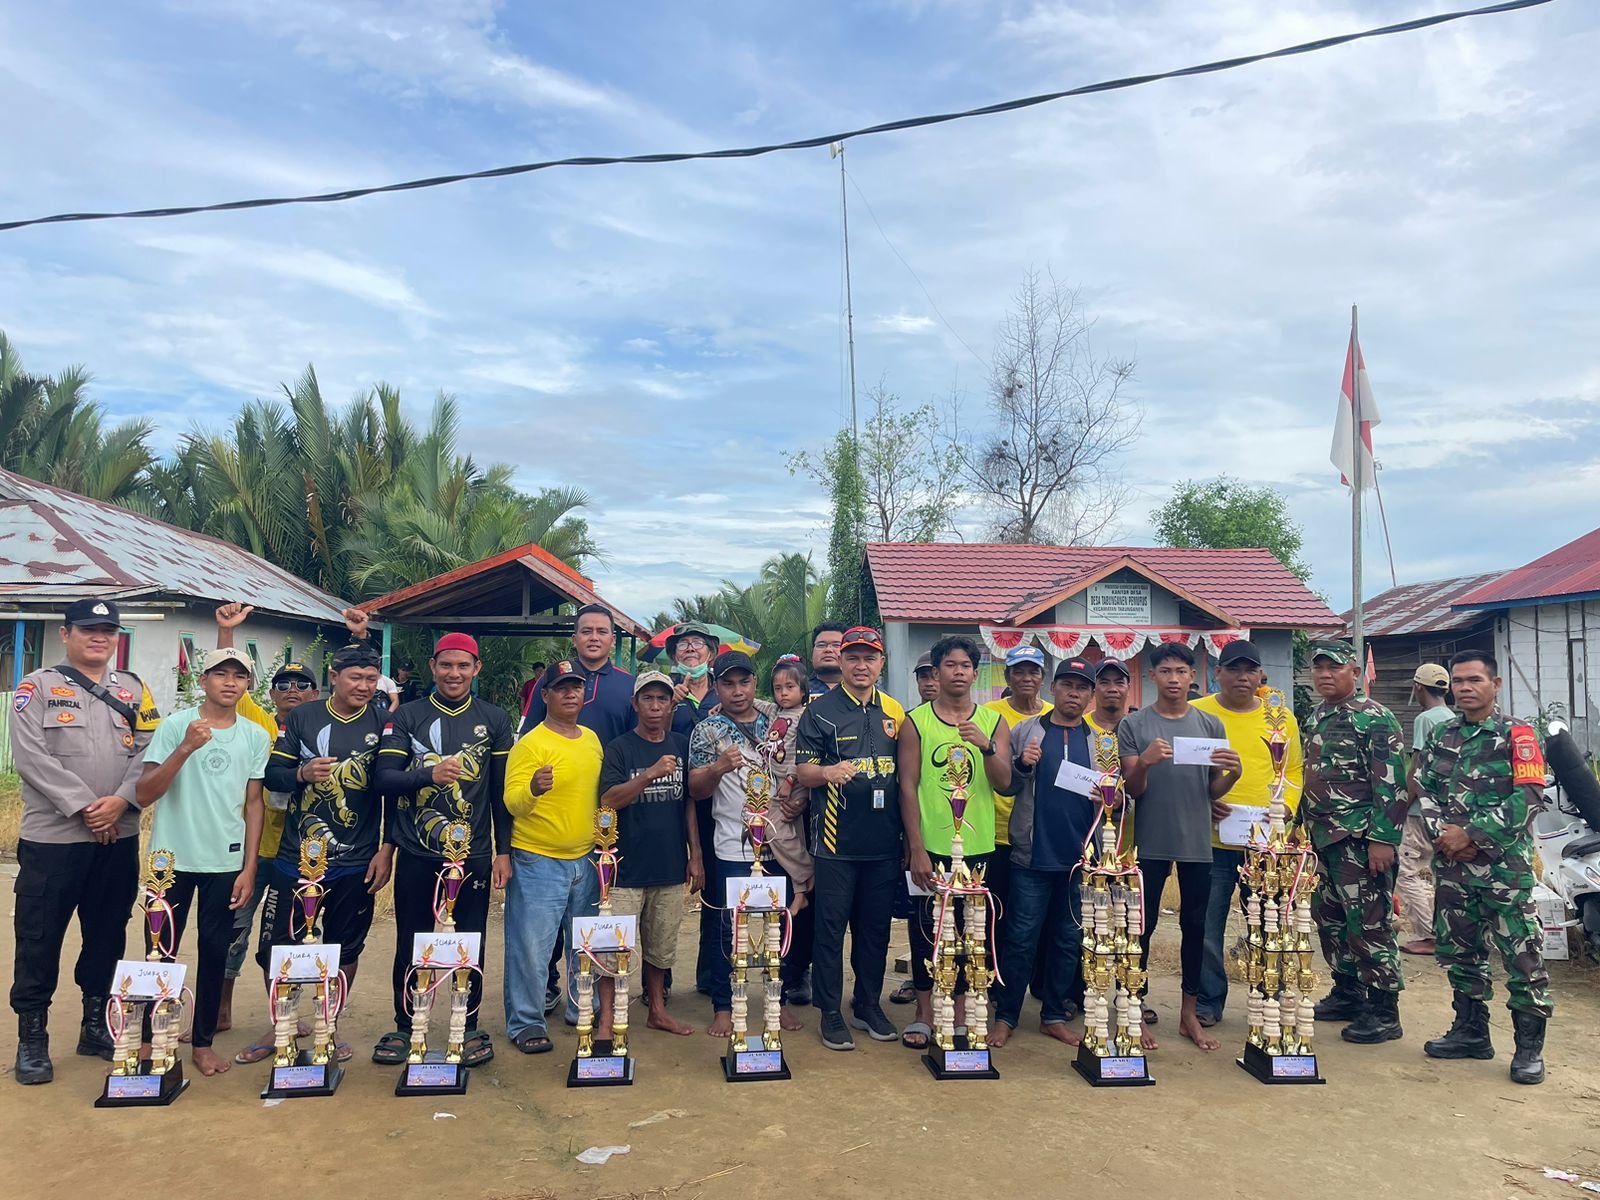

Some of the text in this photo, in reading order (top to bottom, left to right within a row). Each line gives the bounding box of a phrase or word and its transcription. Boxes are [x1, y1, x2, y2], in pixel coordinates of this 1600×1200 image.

[1090, 595, 1101, 606] DESA
[48, 699, 82, 710] FAHRIZAL
[265, 888, 279, 920] NIKE
